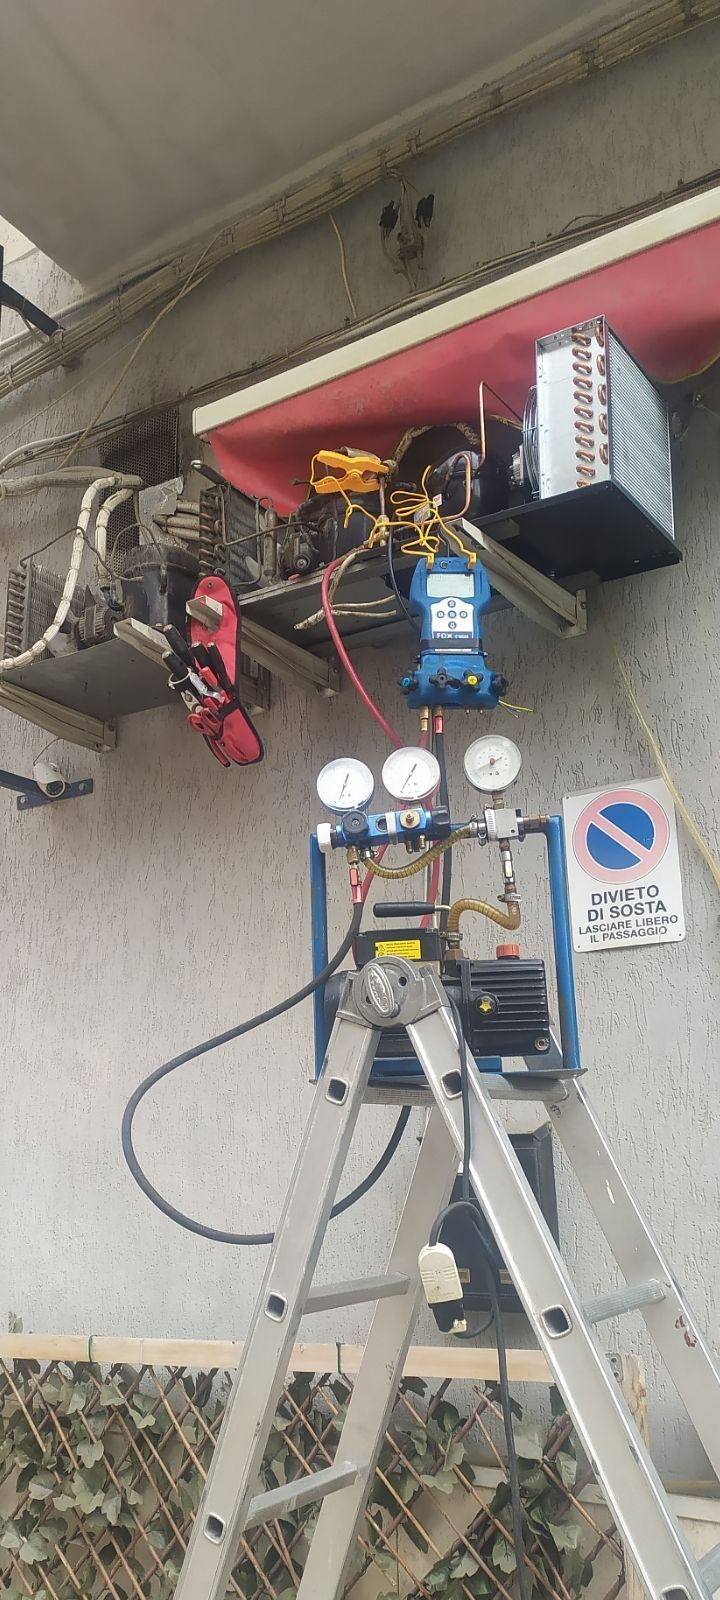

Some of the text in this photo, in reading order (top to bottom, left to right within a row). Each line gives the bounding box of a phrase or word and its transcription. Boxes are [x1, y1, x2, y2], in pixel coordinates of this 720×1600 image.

[591, 885, 659, 906] DIVIETO
[587, 900, 667, 922] DI SOSTA
[579, 915, 678, 935] LASCIARE LIBERO
[590, 926, 667, 943] IL PASSAGGIO
